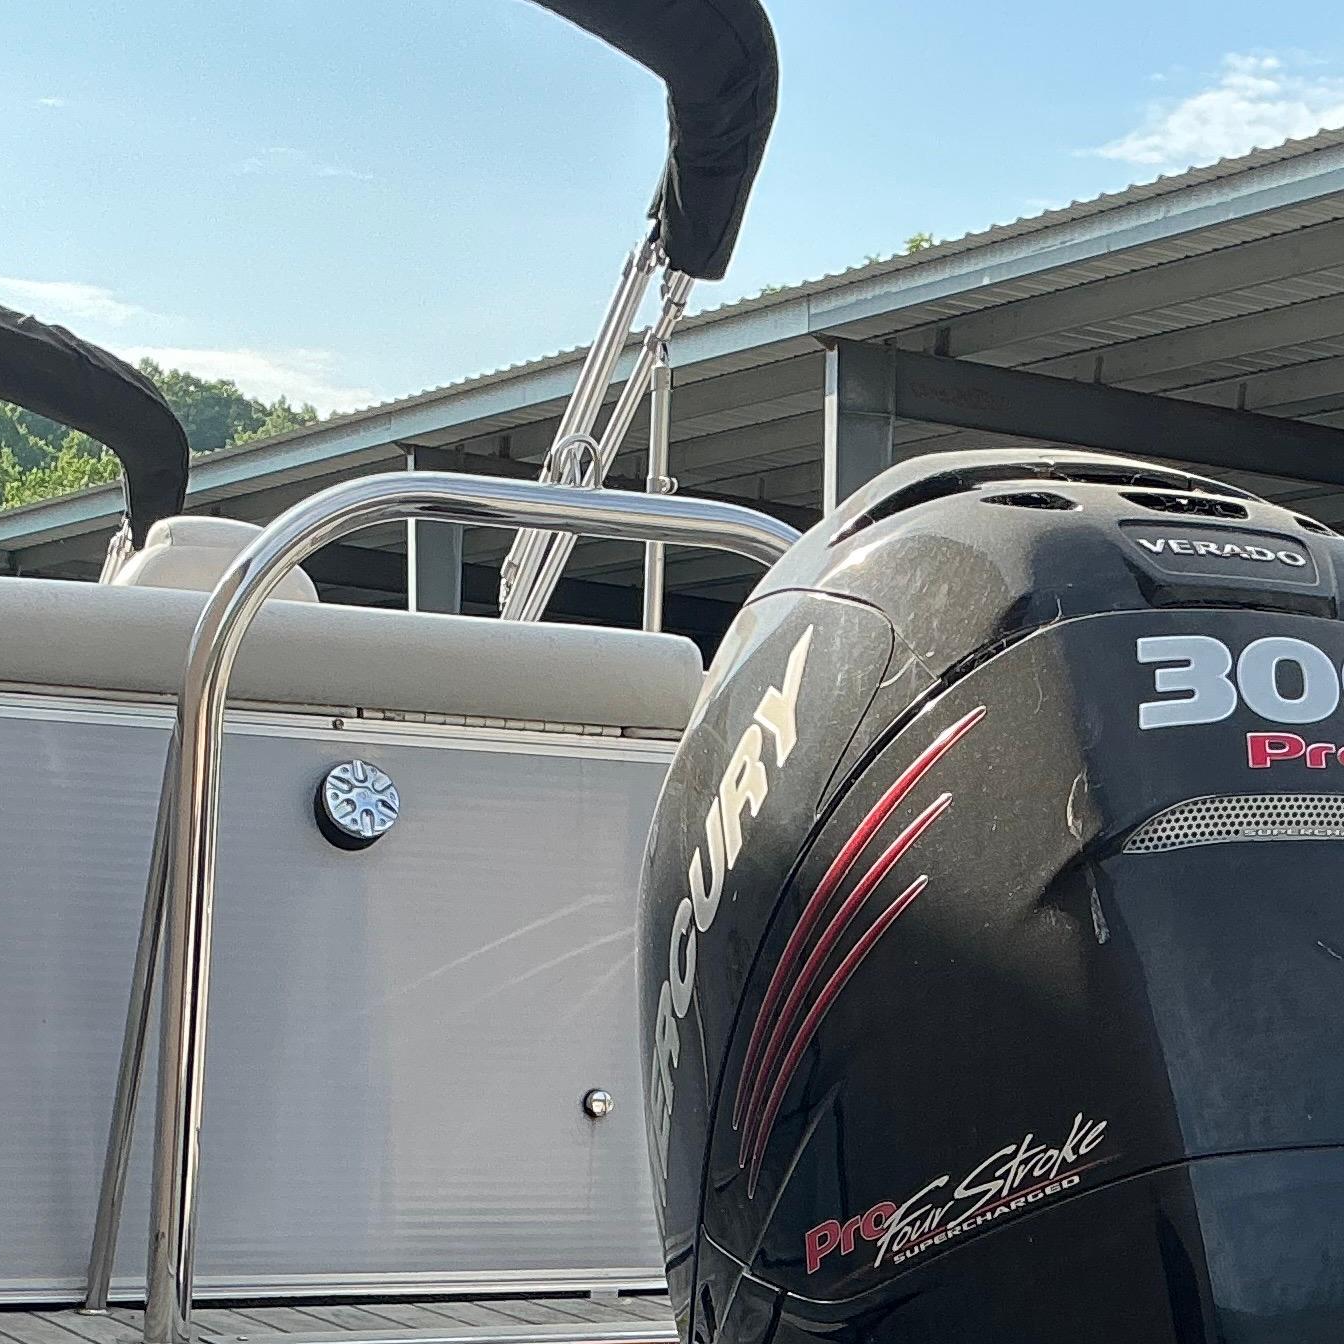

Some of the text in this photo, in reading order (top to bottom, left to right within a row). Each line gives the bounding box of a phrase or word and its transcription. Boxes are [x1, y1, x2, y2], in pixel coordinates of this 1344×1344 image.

[1136, 538, 1307, 567] VERADO
[806, 1201, 897, 1274] Pro
[893, 1174, 1080, 1265] SUPERCHARGED
